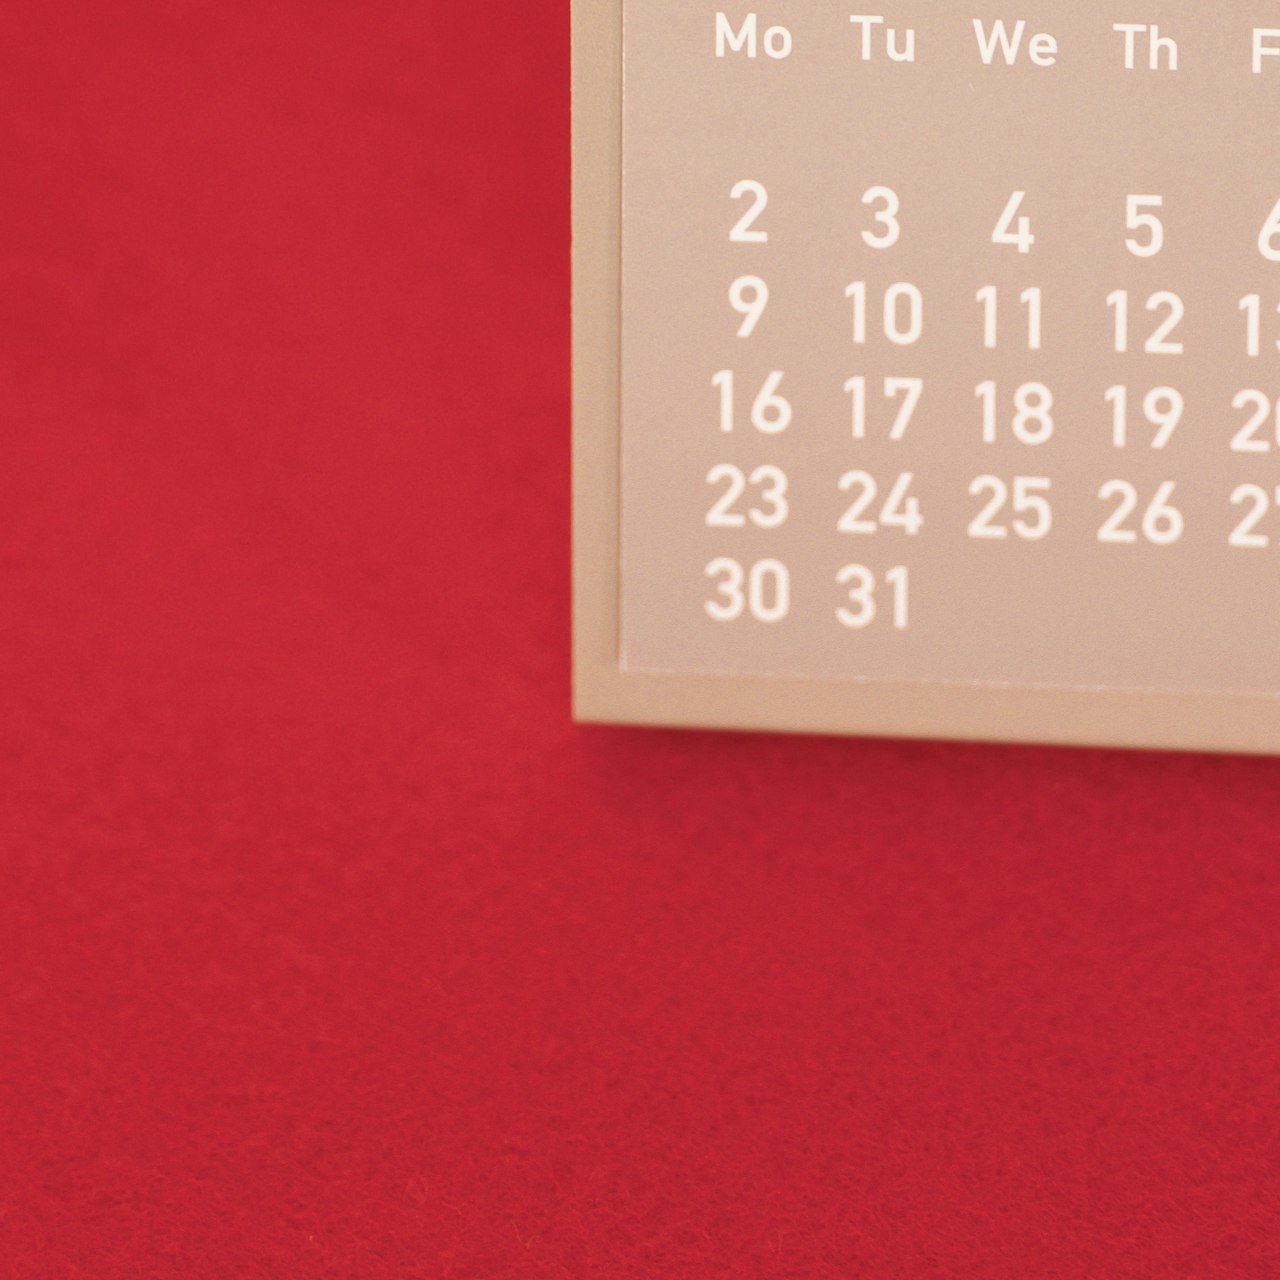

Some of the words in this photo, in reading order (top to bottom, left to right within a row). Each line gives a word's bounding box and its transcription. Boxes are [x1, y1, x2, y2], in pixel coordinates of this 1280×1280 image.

[715, 12, 793, 60] Mo
[849, 14, 915, 63] Tu
[972, 18, 1058, 67] We
[1112, 23, 1178, 71] Th
[729, 179, 768, 243] 2
[861, 185, 900, 249] 3
[991, 190, 1035, 254] 4
[1125, 194, 1164, 257] 5
[728, 275, 769, 338] 9
[844, 281, 923, 345] 10
[975, 285, 1041, 350] 11
[1106, 289, 1184, 354] 12
[712, 369, 792, 433] 16
[843, 376, 923, 440] 17
[975, 380, 1054, 445] 18
[1105, 385, 1184, 449] 19
[706, 463, 788, 528] 23
[837, 470, 923, 534] 24
[968, 474, 1052, 539] 25
[1097, 479, 1183, 544] 26
[705, 557, 789, 622] 30
[836, 564, 908, 628] 31
